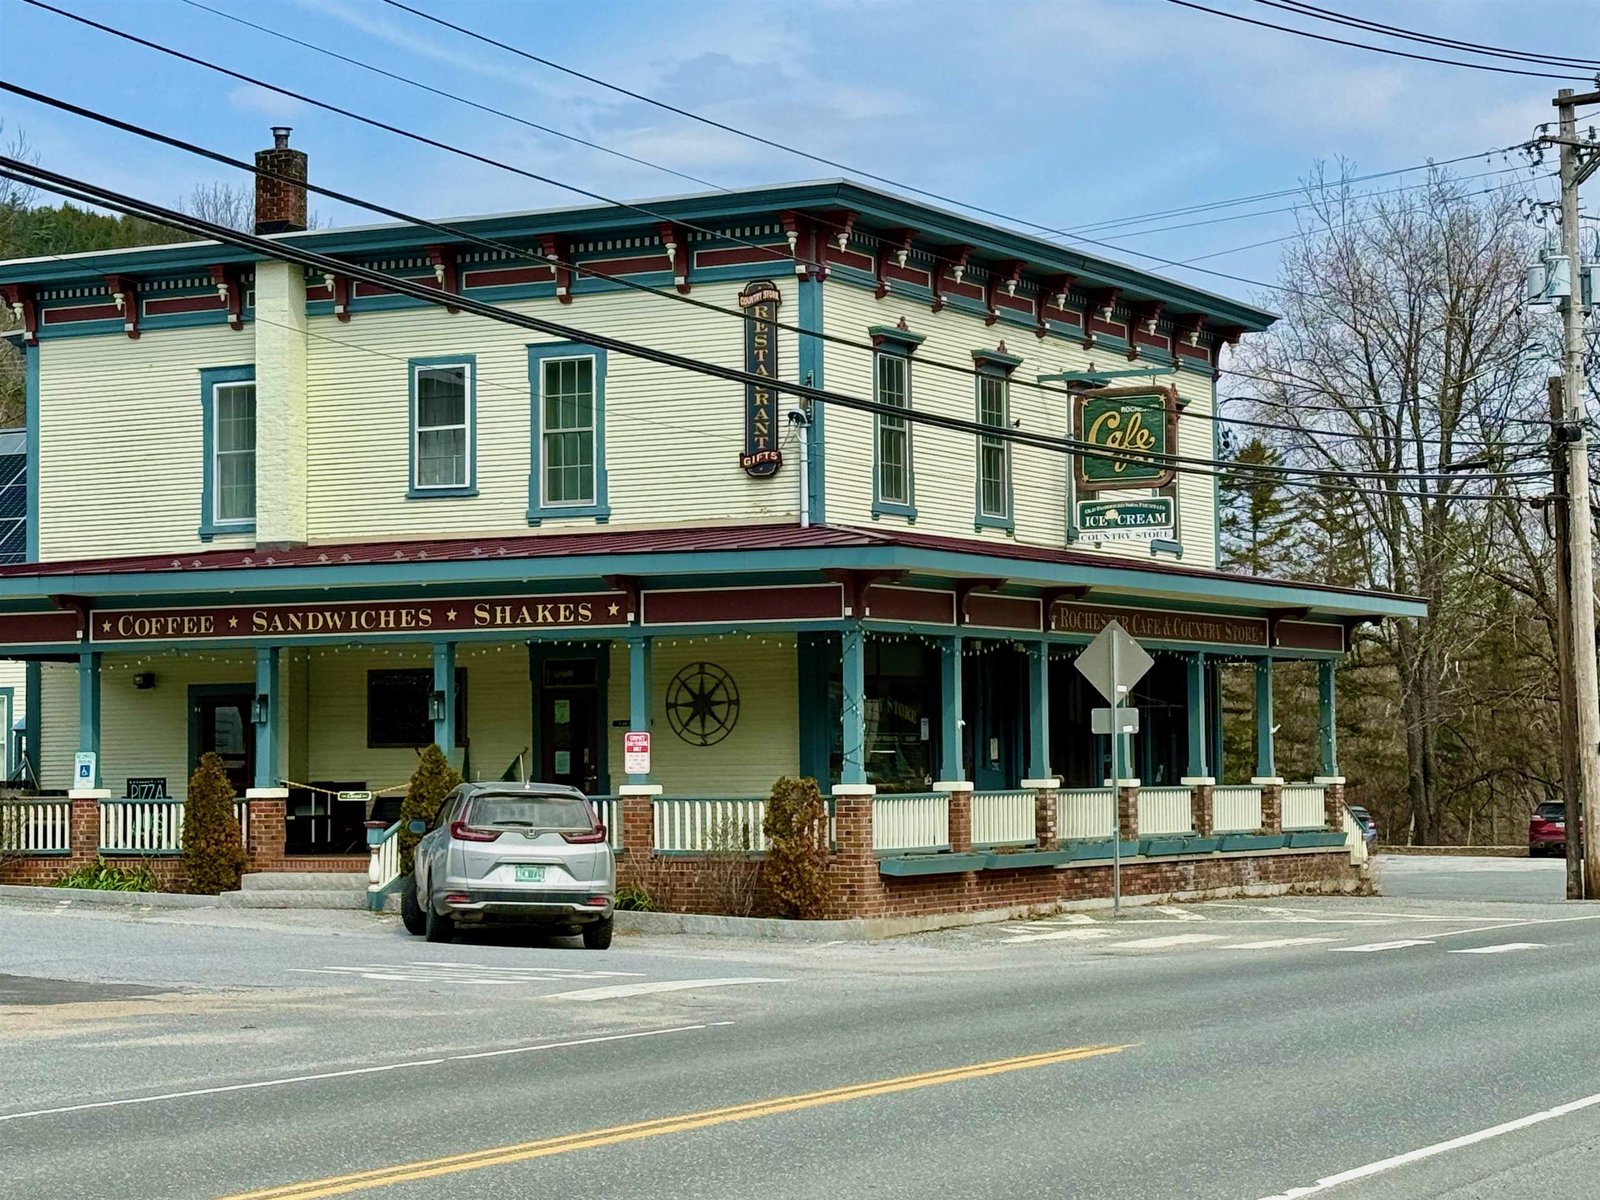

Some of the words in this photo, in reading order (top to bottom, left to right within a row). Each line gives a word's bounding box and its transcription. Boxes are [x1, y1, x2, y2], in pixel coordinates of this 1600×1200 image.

[753, 305, 770, 448] RESTARANT
[1120, 403, 1160, 413] ROCHE
[1087, 411, 1156, 472] Cafe
[743, 451, 778, 466] GIFTS
[1085, 515, 1108, 527] ICE
[1117, 512, 1167, 526] CREAM
[1080, 532, 1133, 542] COUNTRY
[1135, 530, 1172, 539] STORE
[117, 614, 215, 636] COFFEE
[252, 608, 432, 632] SANDWICHES
[474, 602, 592, 626] SHAKES
[1132, 613, 1161, 634] CAFE
[1163, 616, 1171, 636] &
[1173, 617, 1221, 640] COUNTRY
[1225, 622, 1258, 642] STORE
[131, 783, 164, 800] PIZZA
